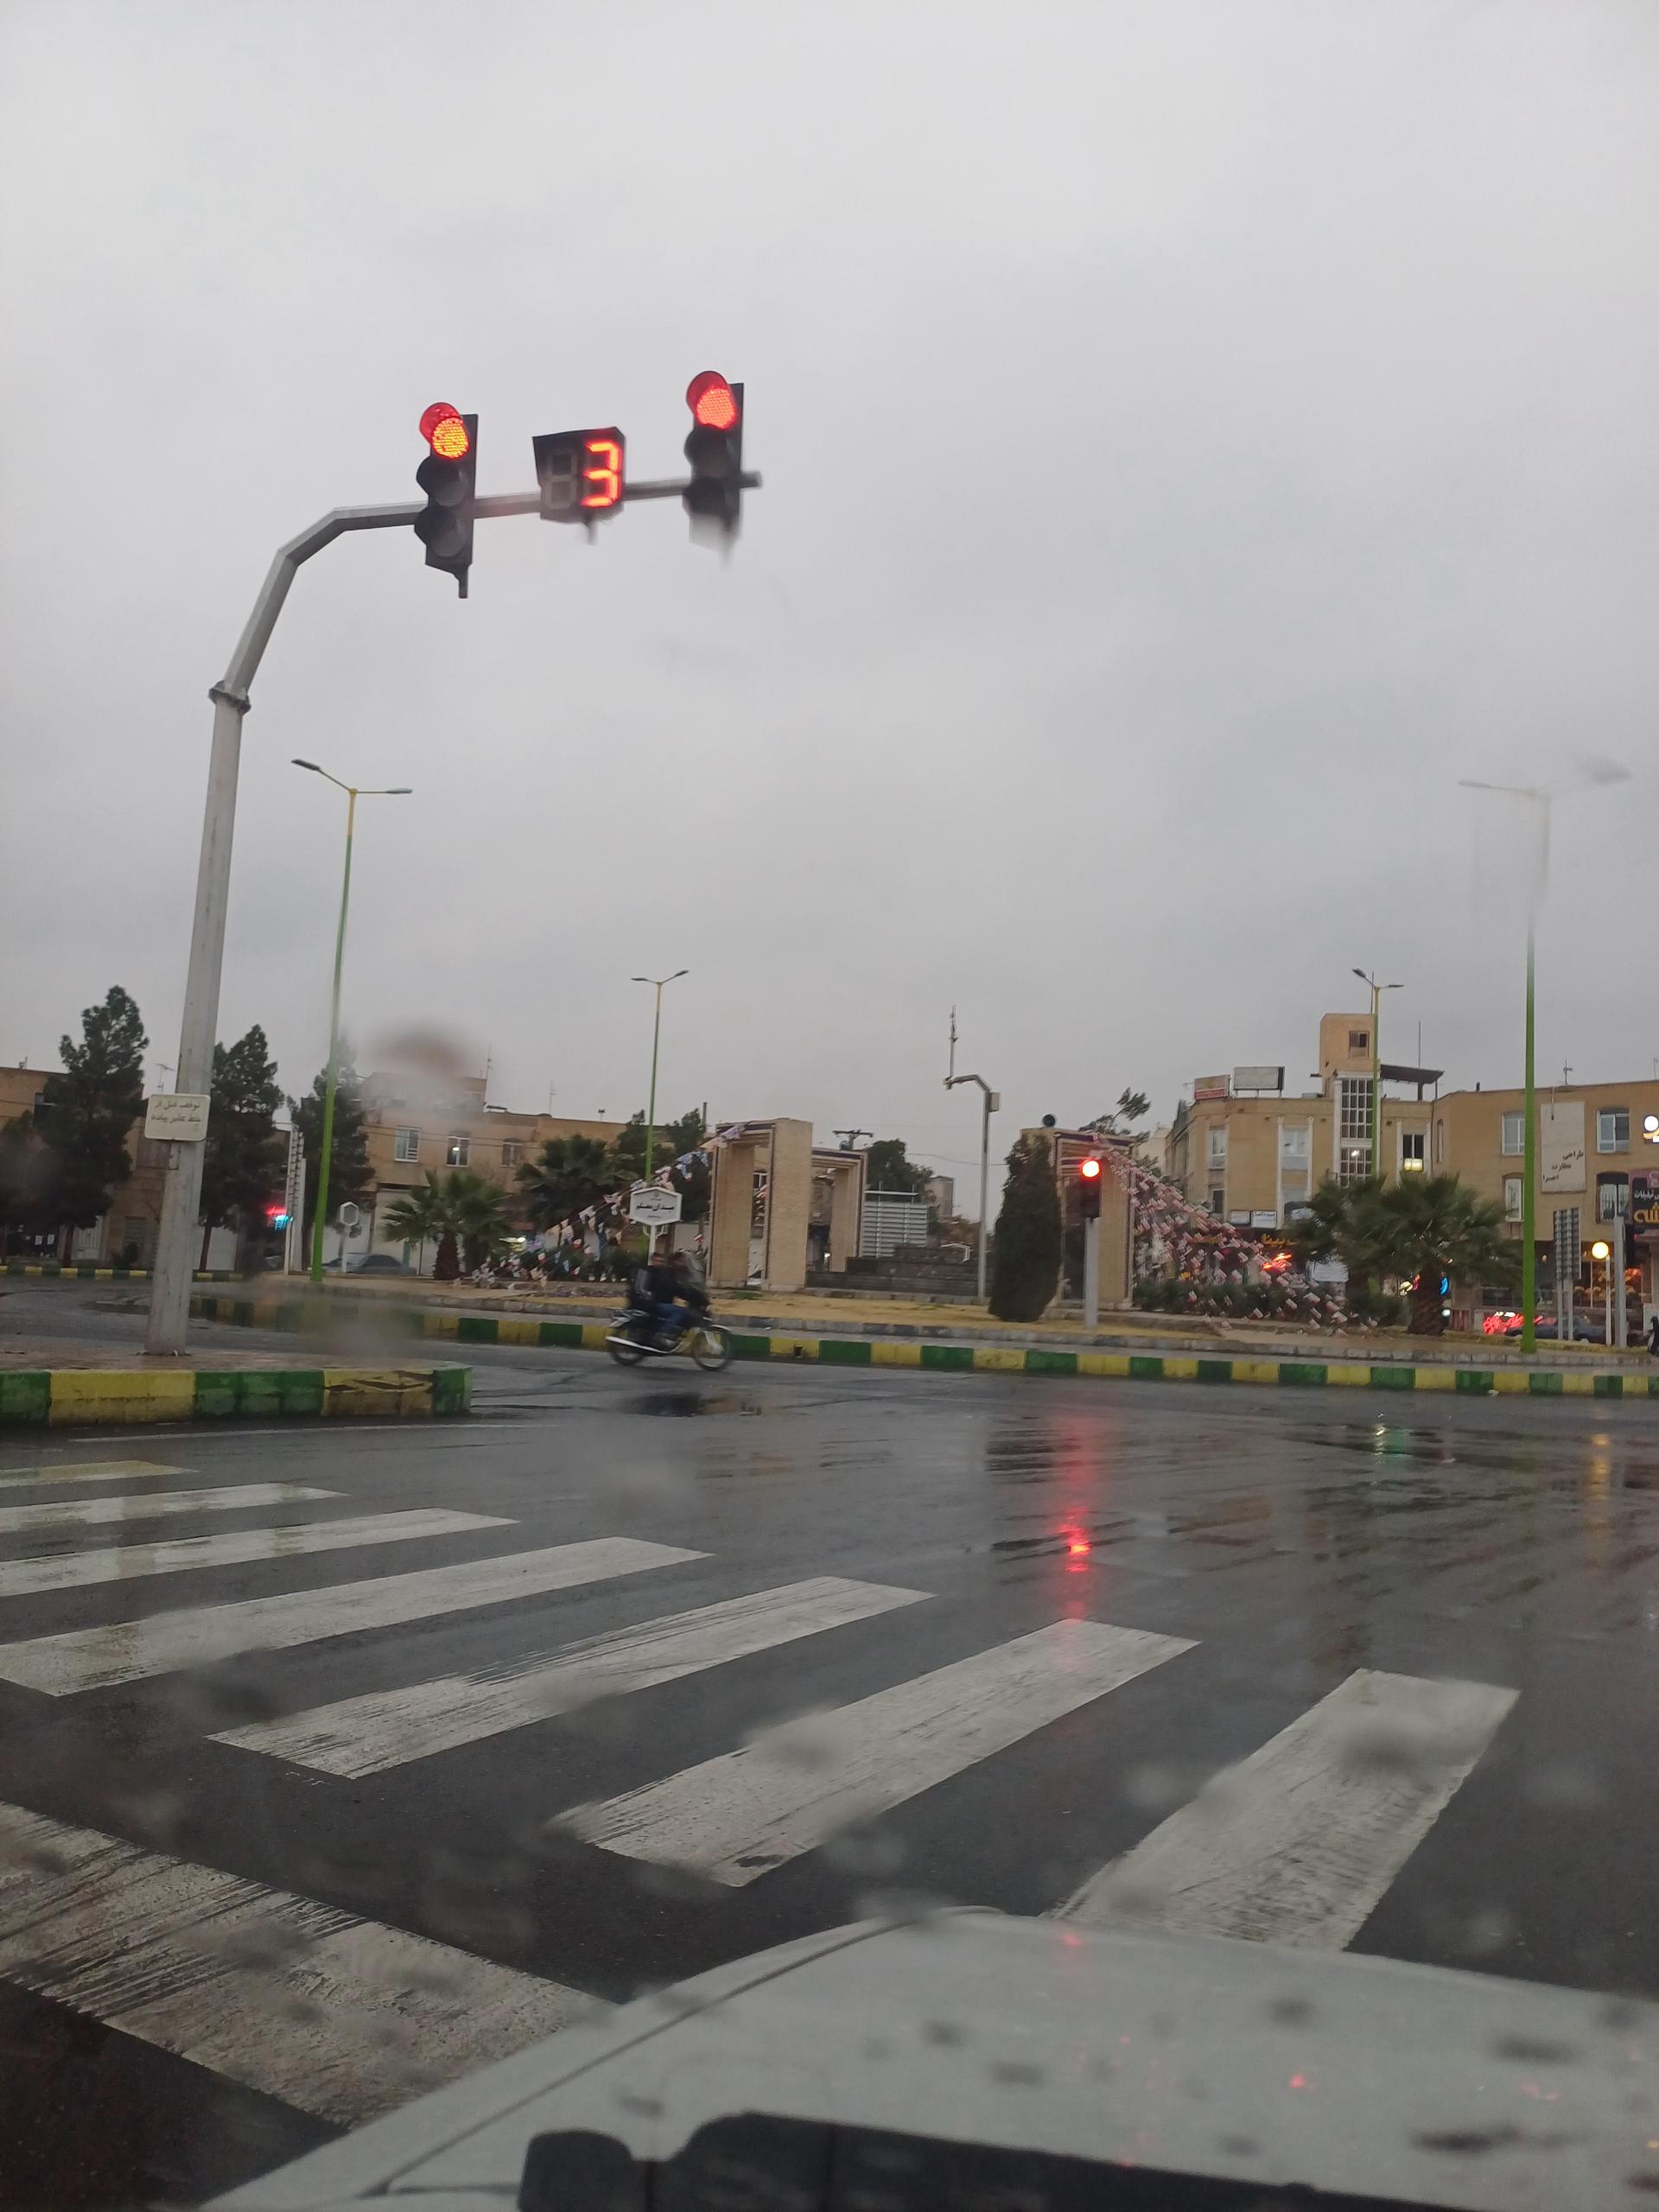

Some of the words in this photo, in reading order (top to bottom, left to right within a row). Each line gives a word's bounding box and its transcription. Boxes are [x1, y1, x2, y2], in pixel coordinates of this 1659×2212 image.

[582, 441, 620, 507] 3
[163, 1099, 178, 1110] قبل
[179, 1100, 200, 1111] توقف
[1562, 1149, 1584, 1160] طراحی
[1552, 1162, 1572, 1172] نظارت
[1543, 1173, 1559, 1183] اجرا
